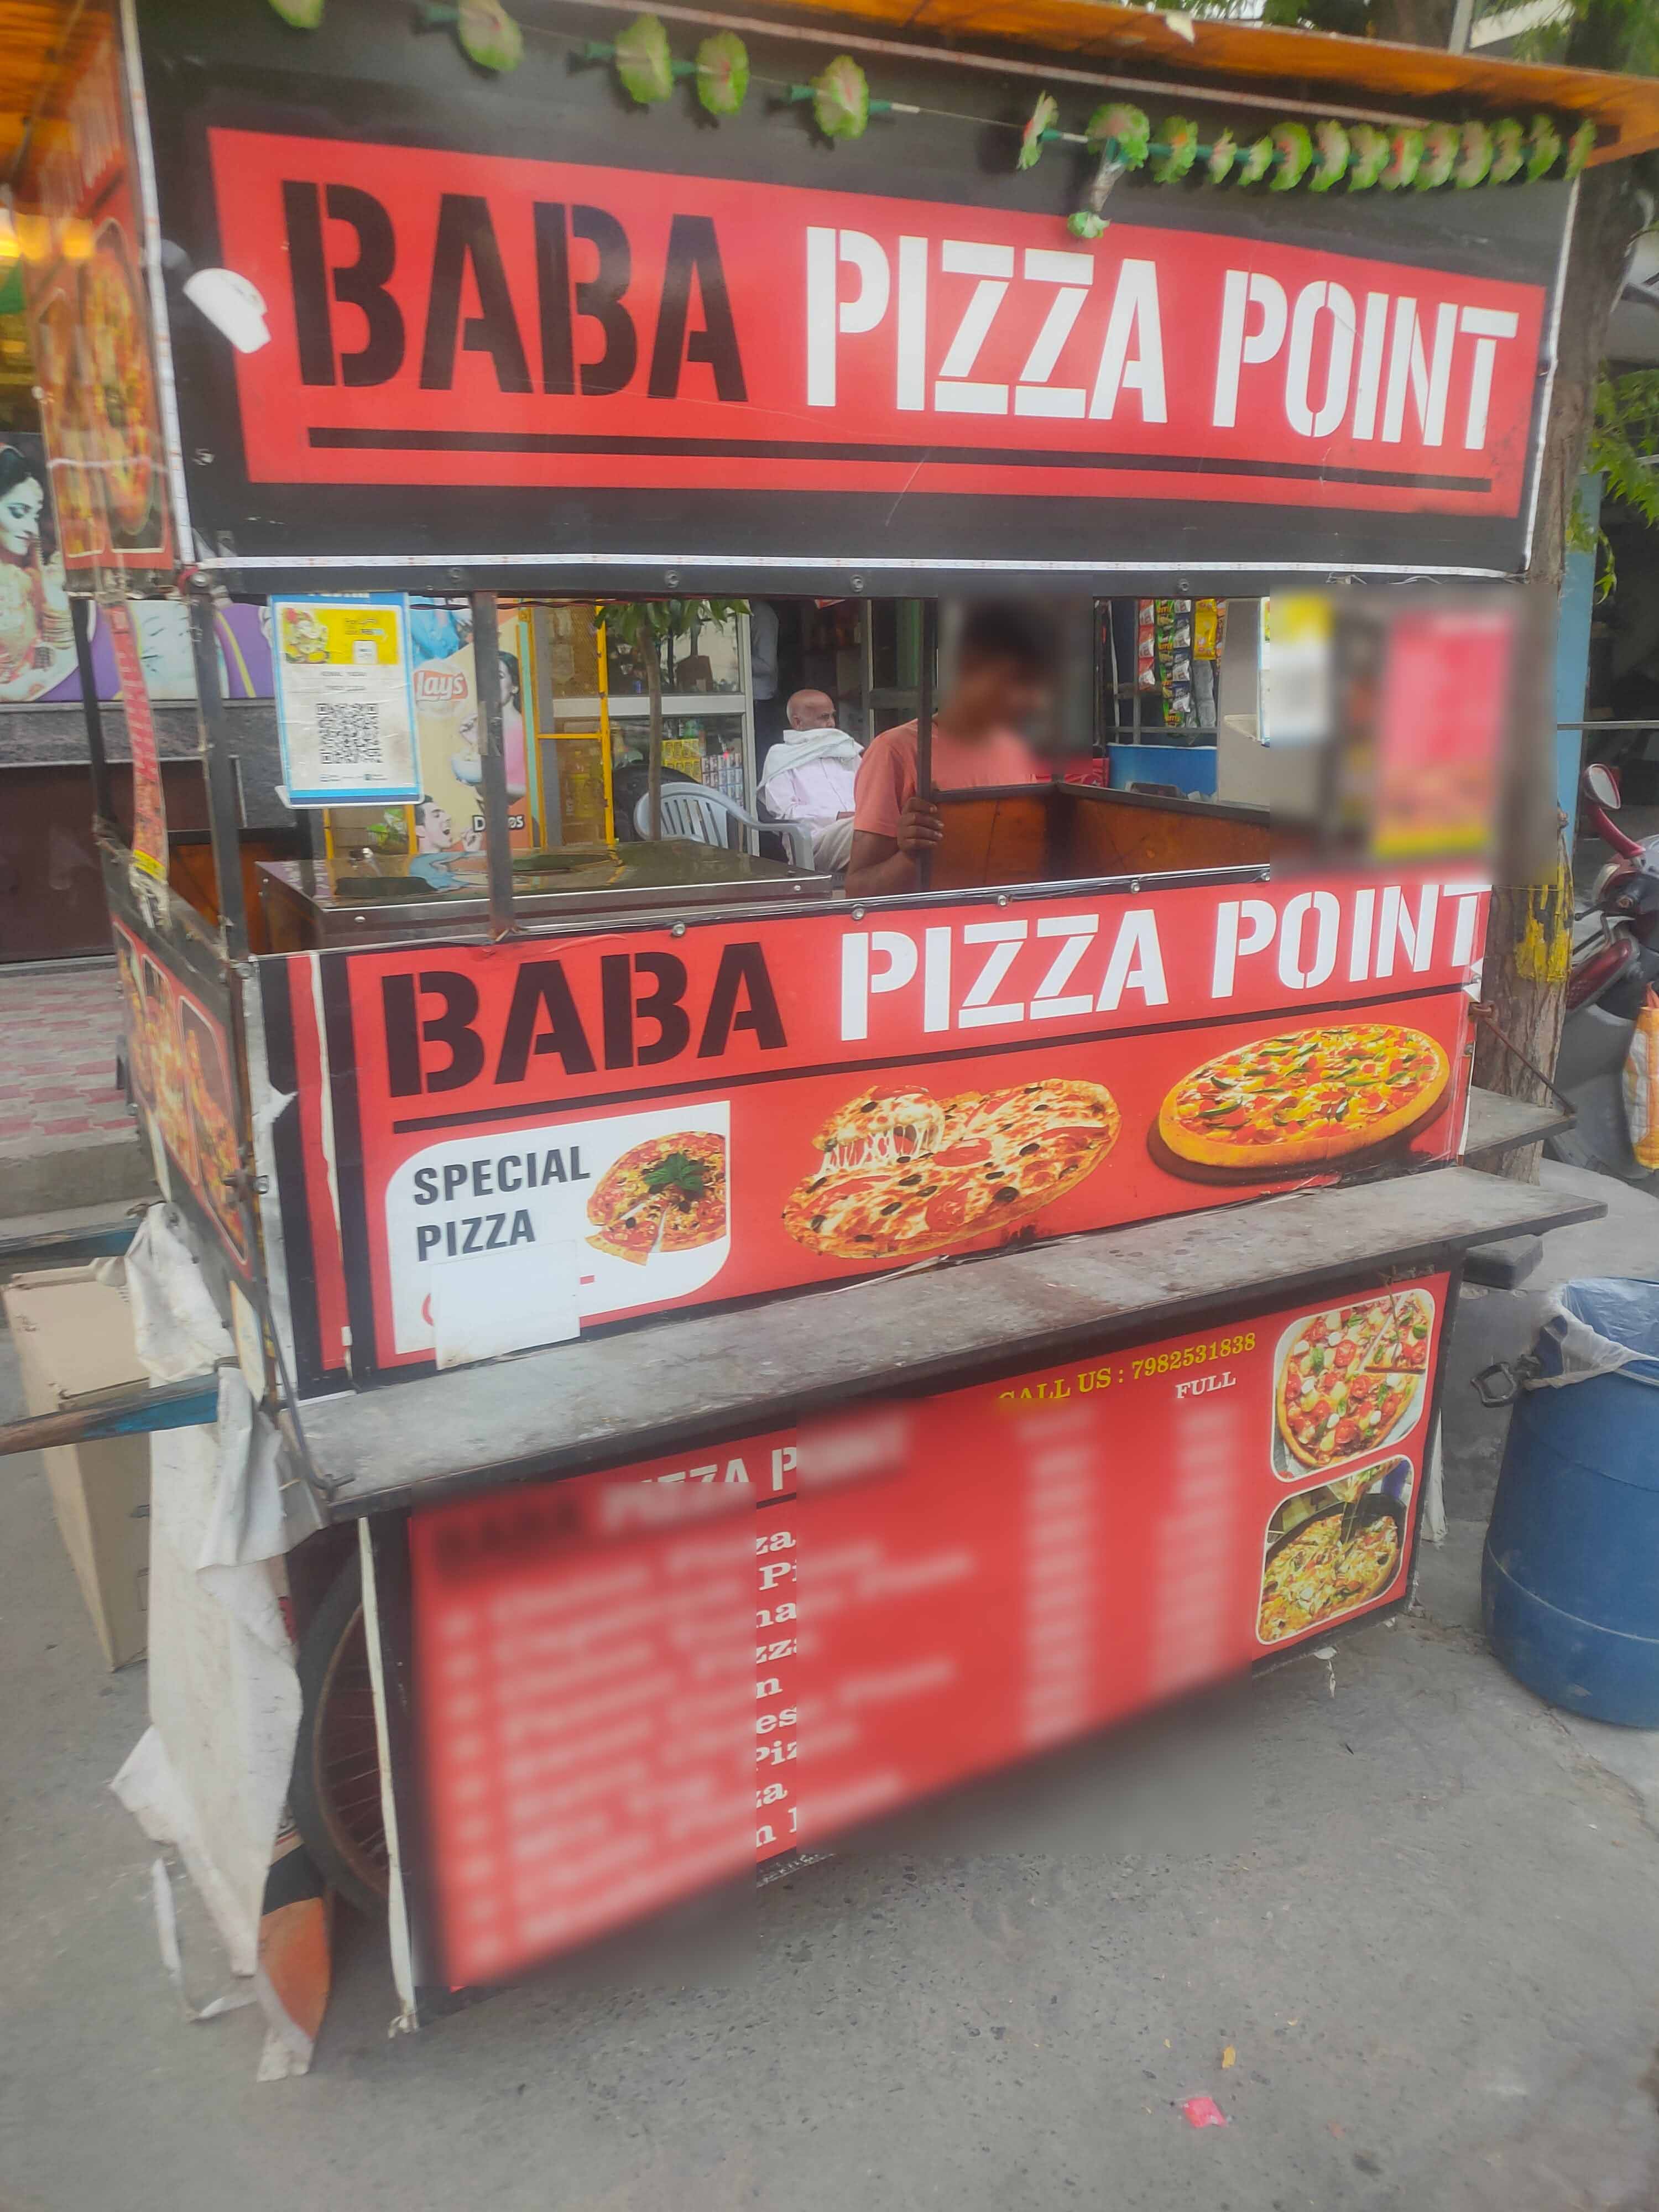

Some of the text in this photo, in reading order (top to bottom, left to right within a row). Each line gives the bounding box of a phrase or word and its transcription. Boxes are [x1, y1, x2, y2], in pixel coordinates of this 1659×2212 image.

[281, 179, 1519, 450] BABA PIZZA POINT
[381, 885, 1493, 1098] BABA PIZZA POINT
[413, 1146, 591, 1206] SPECIAL
[416, 1209, 536, 1262] PIZZA
[1077, 1367, 1112, 1393] US
[1133, 1332, 1256, 1379] 7982531838
[1175, 1371, 1236, 1398] FULL
